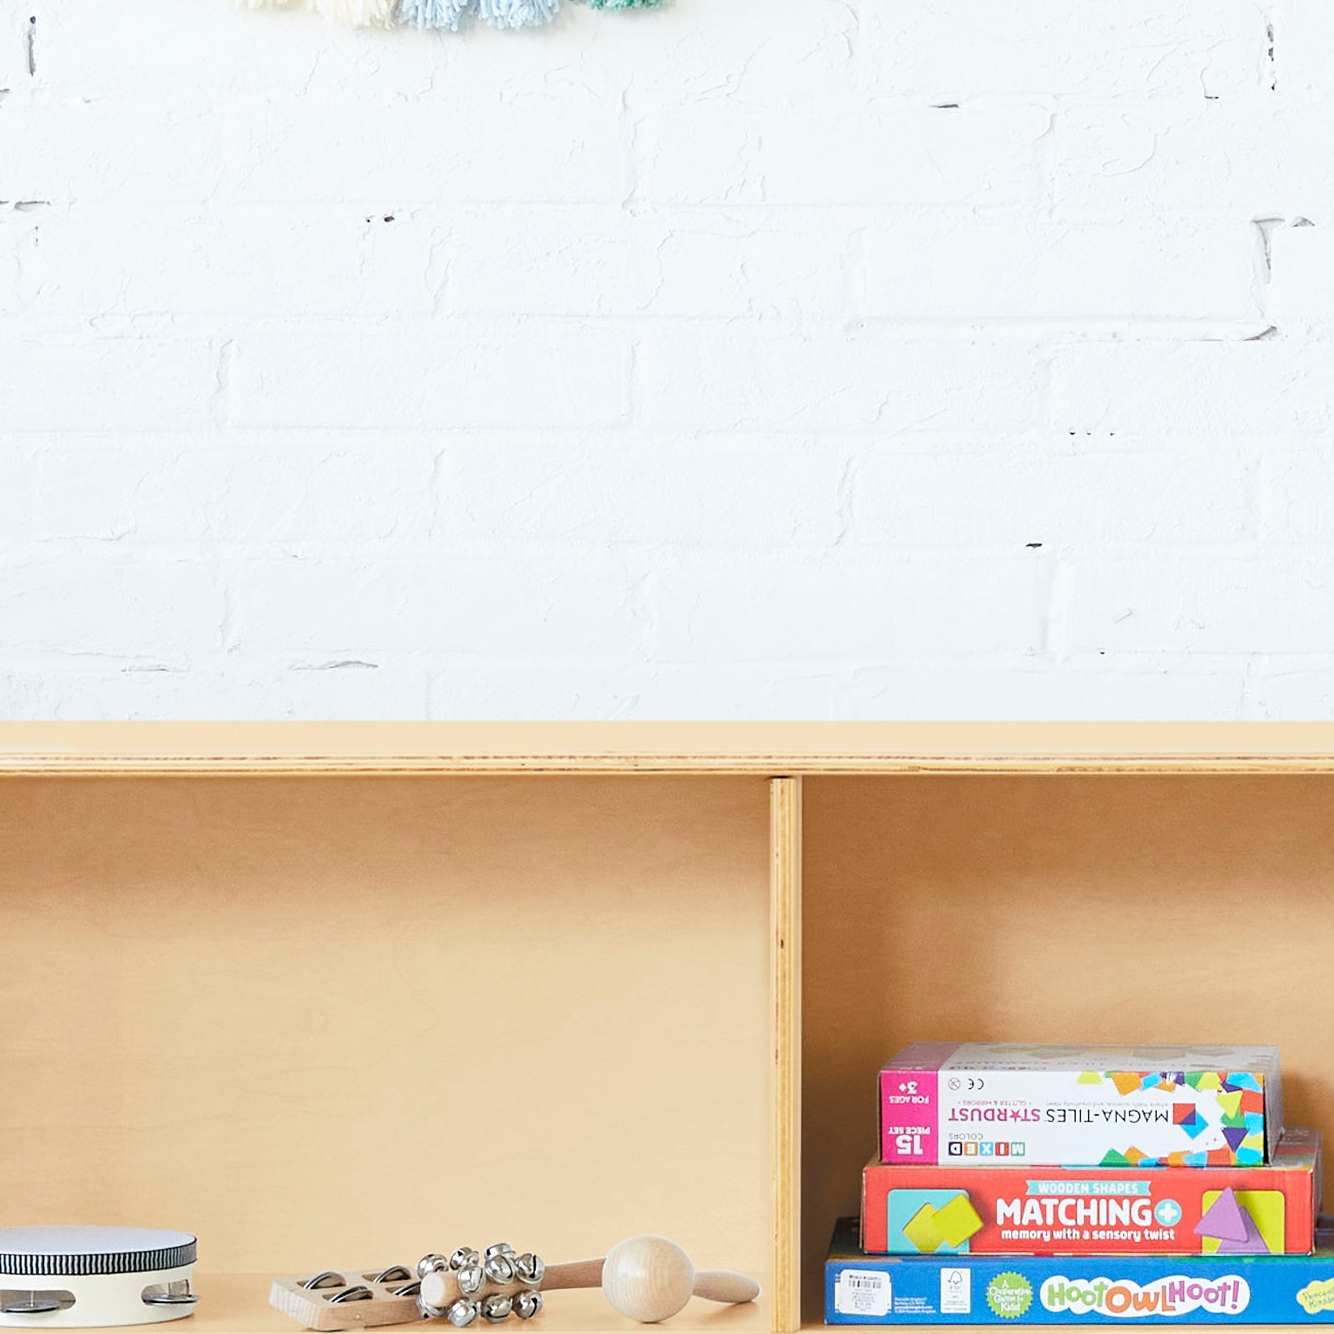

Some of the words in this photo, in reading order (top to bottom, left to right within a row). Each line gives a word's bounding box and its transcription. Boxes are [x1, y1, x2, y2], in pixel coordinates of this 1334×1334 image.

[888, 1095, 911, 1104] AGES
[912, 1095, 930, 1104] FOR
[888, 1126, 904, 1135] SET
[905, 1126, 931, 1135] PIECE
[949, 1132, 984, 1140] COLORS
[895, 1135, 923, 1155] 15
[949, 1142, 1025, 1156] MIXED
[1038, 1183, 1089, 1194] WOODEN
[1092, 1183, 1139, 1194] SHAPES
[1001, 1230, 1051, 1242] memory
[1053, 1228, 1080, 1240] with
[1082, 1230, 1090, 1240] a
[1092, 1230, 1141, 1242] sensory
[1143, 1228, 1175, 1240] twist
